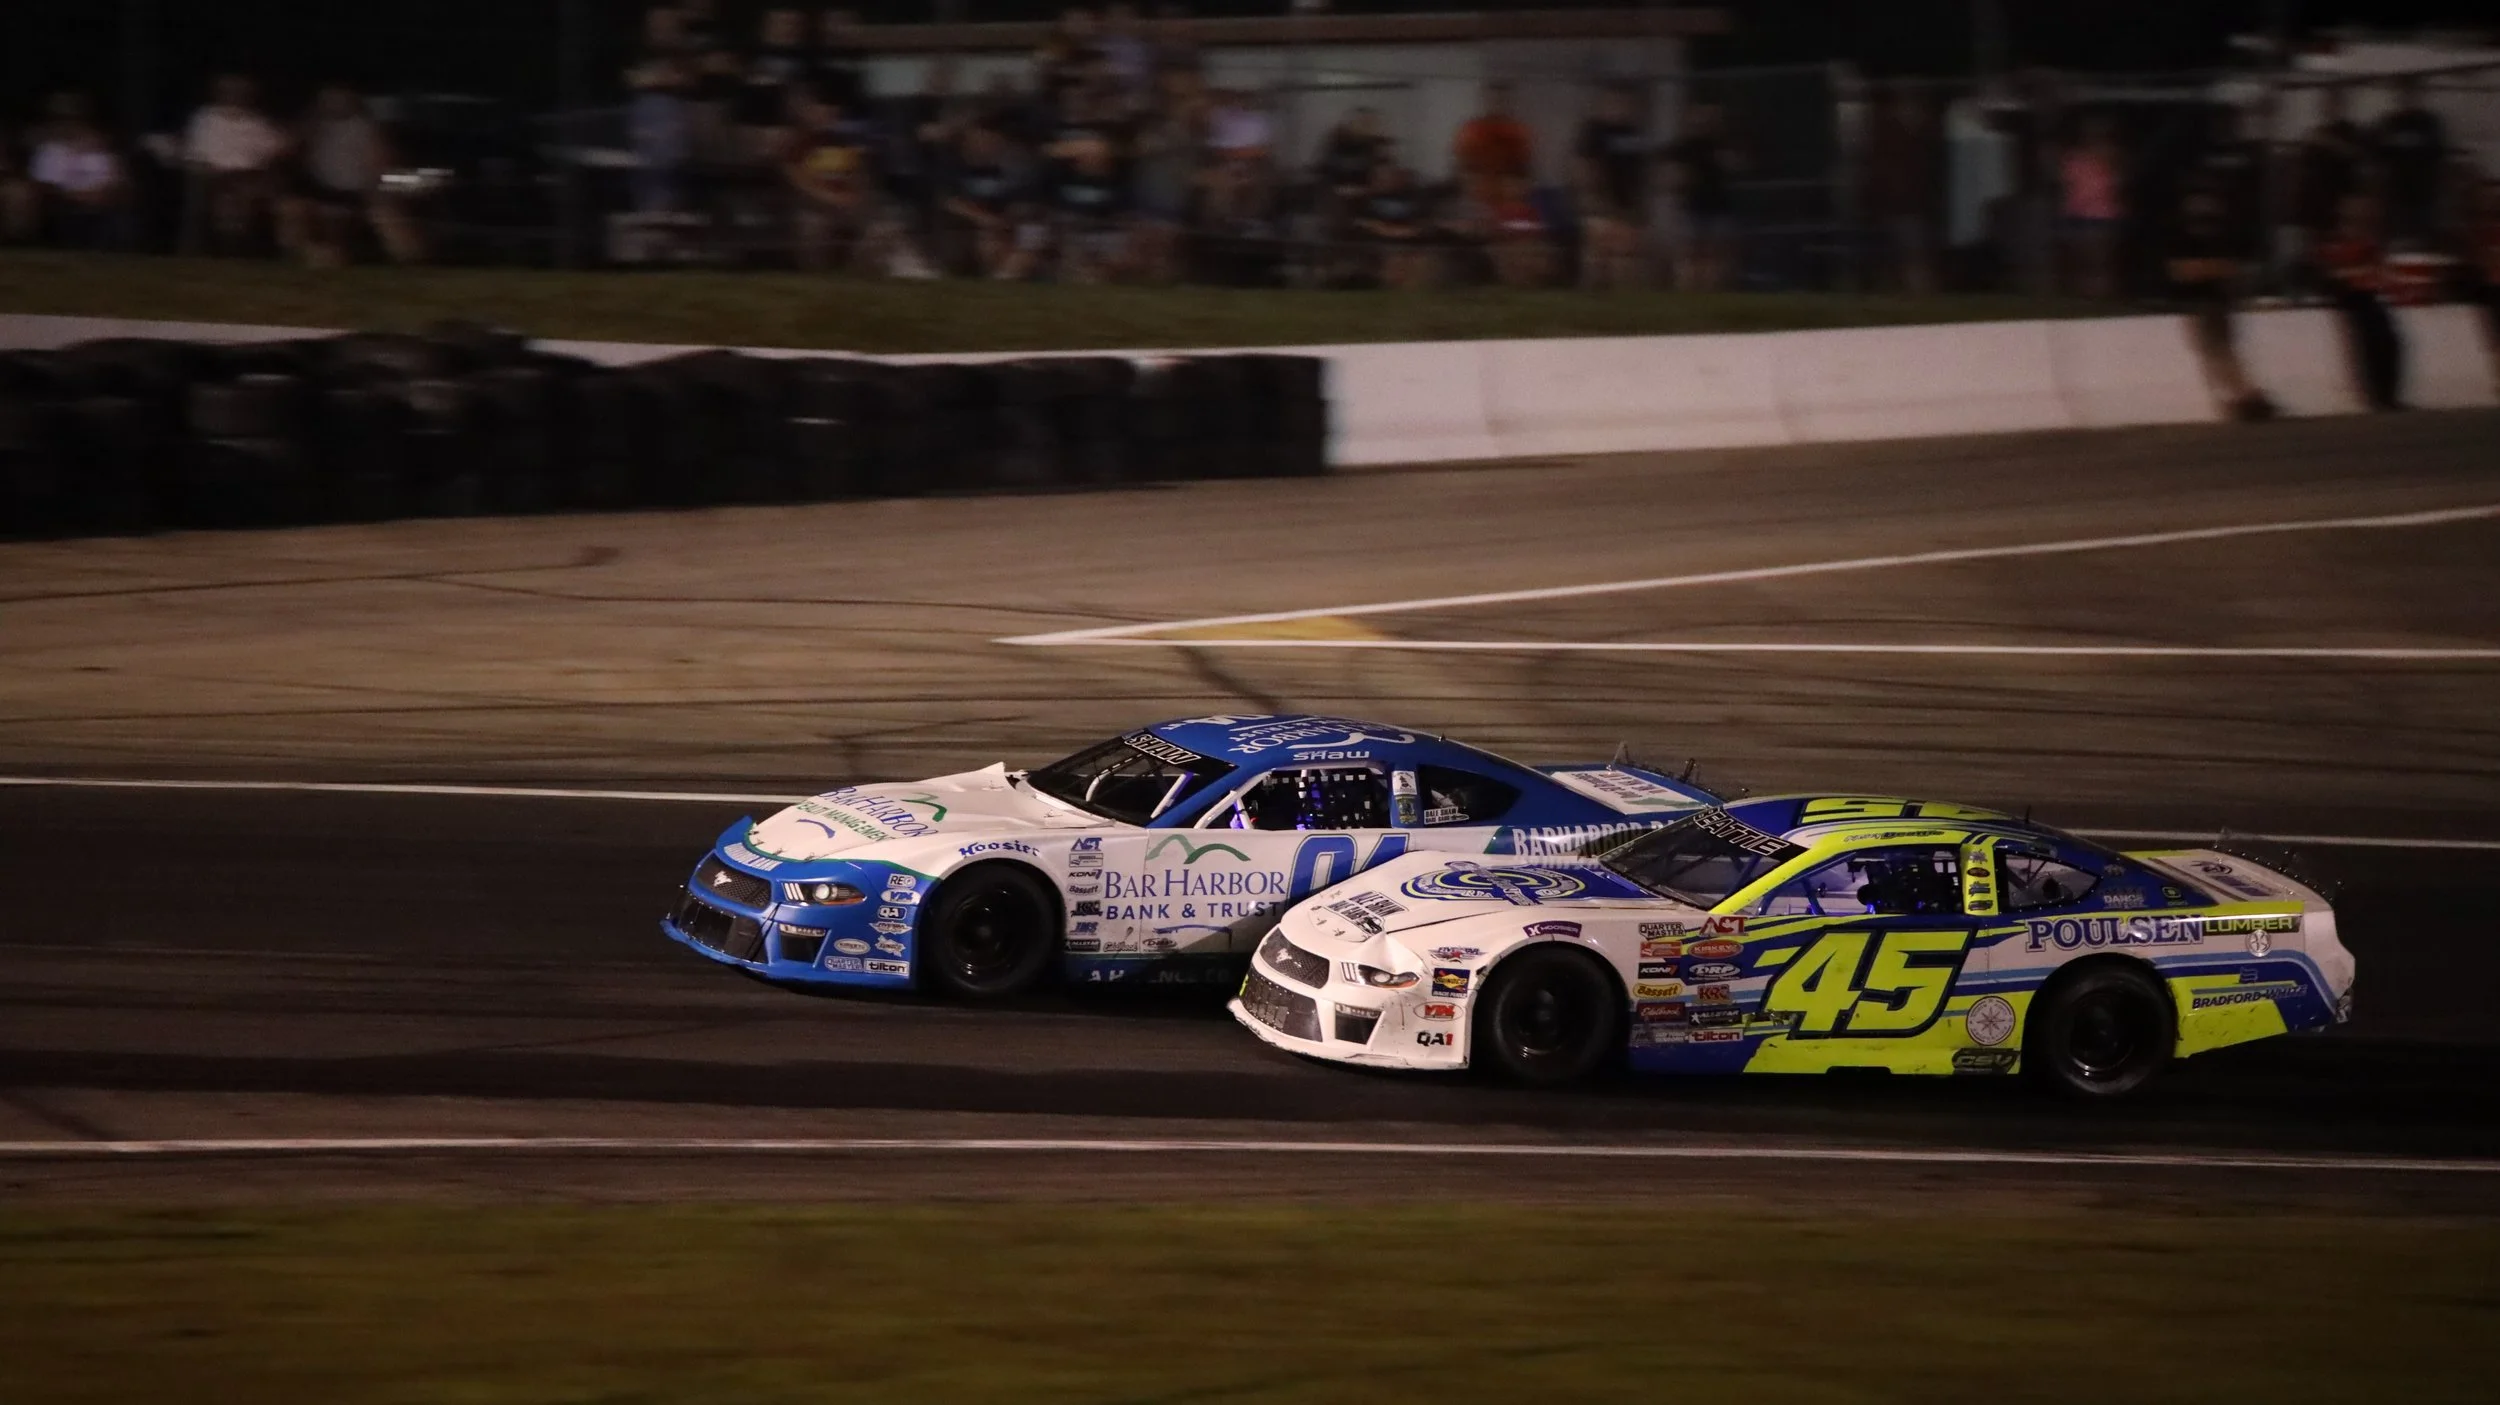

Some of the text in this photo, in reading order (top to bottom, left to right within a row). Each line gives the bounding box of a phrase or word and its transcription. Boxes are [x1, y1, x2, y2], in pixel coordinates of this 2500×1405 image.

[959, 840, 1040, 857] Hoosier
[1104, 868, 1287, 899] BAR HARBOR
[1106, 902, 1281, 920] BANK & TRUST
[2026, 914, 2294, 952] POULSEN LUMBER
[868, 961, 906, 973] tilton
[1763, 929, 1971, 1034] 45
[1638, 985, 1679, 997] Bassett
[1416, 1031, 1454, 1046] QA1
[1692, 1030, 1740, 1041] tilton
